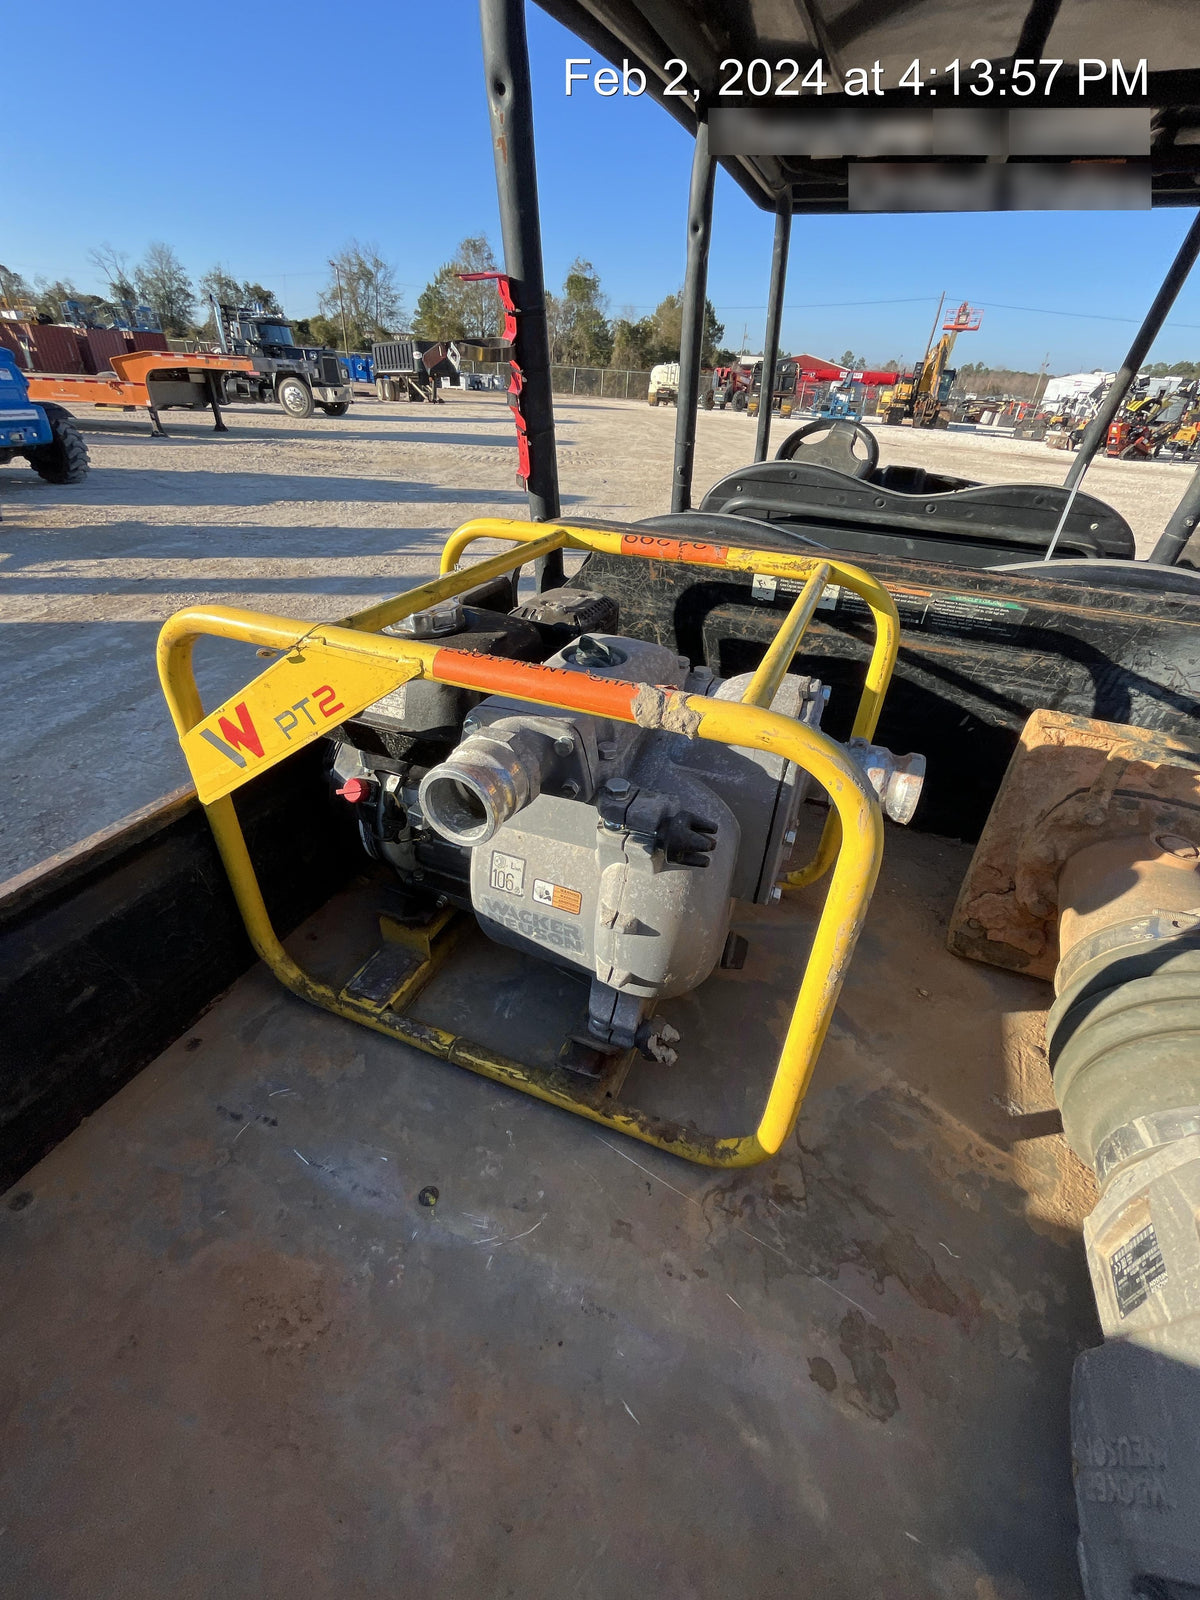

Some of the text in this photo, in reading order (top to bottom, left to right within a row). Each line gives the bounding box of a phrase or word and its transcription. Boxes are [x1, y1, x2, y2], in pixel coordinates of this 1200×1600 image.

[273, 684, 345, 740] PT2
[493, 869, 515, 891] 106
[484, 896, 581, 943] WACKER
